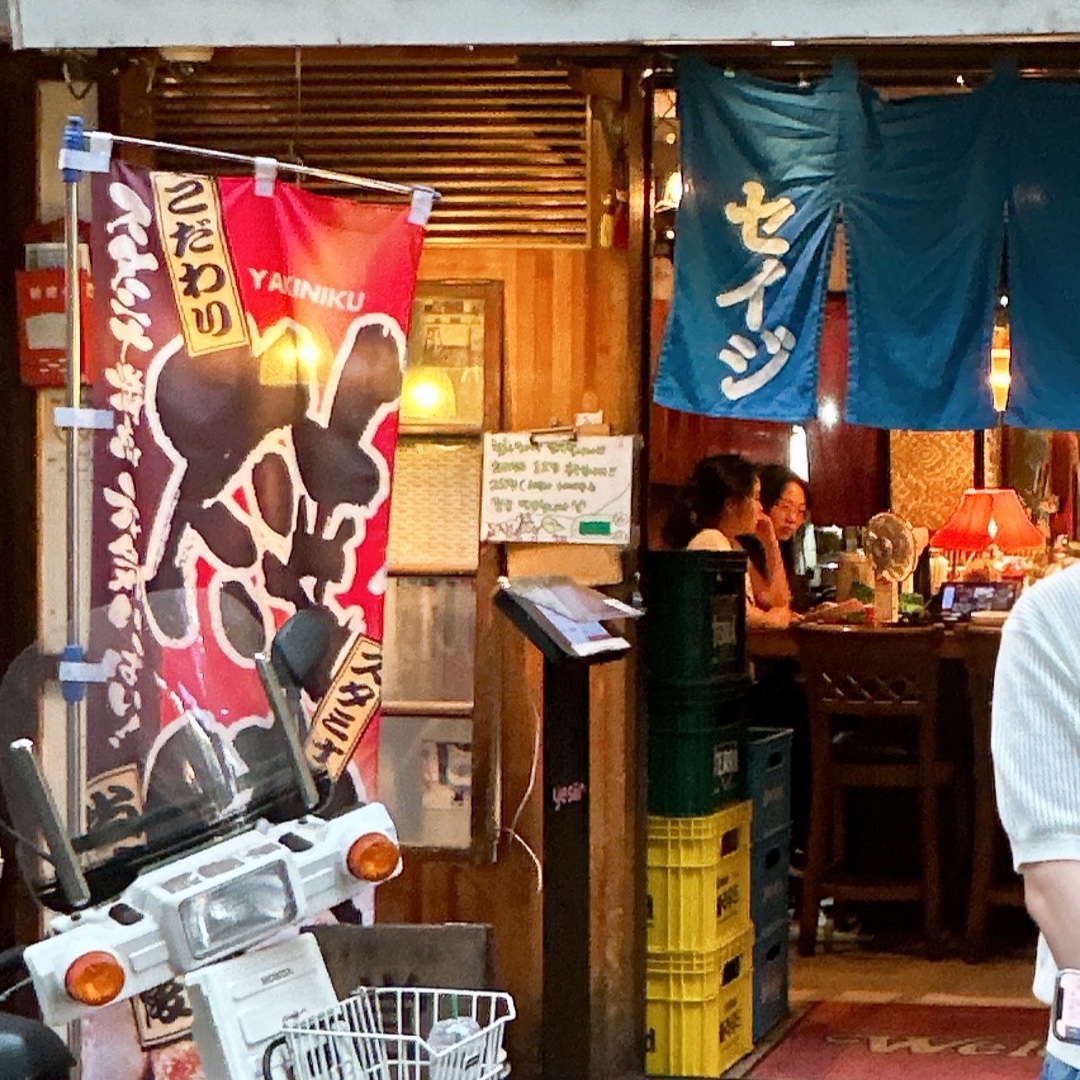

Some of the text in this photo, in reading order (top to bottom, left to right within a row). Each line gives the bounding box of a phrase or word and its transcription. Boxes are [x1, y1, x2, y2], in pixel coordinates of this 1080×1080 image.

[164, 179, 232, 337] こだわり
[247, 267, 366, 312] YAKINIKU
[715, 180, 797, 401] セイジ
[312, 652, 382, 763] スタミナ
